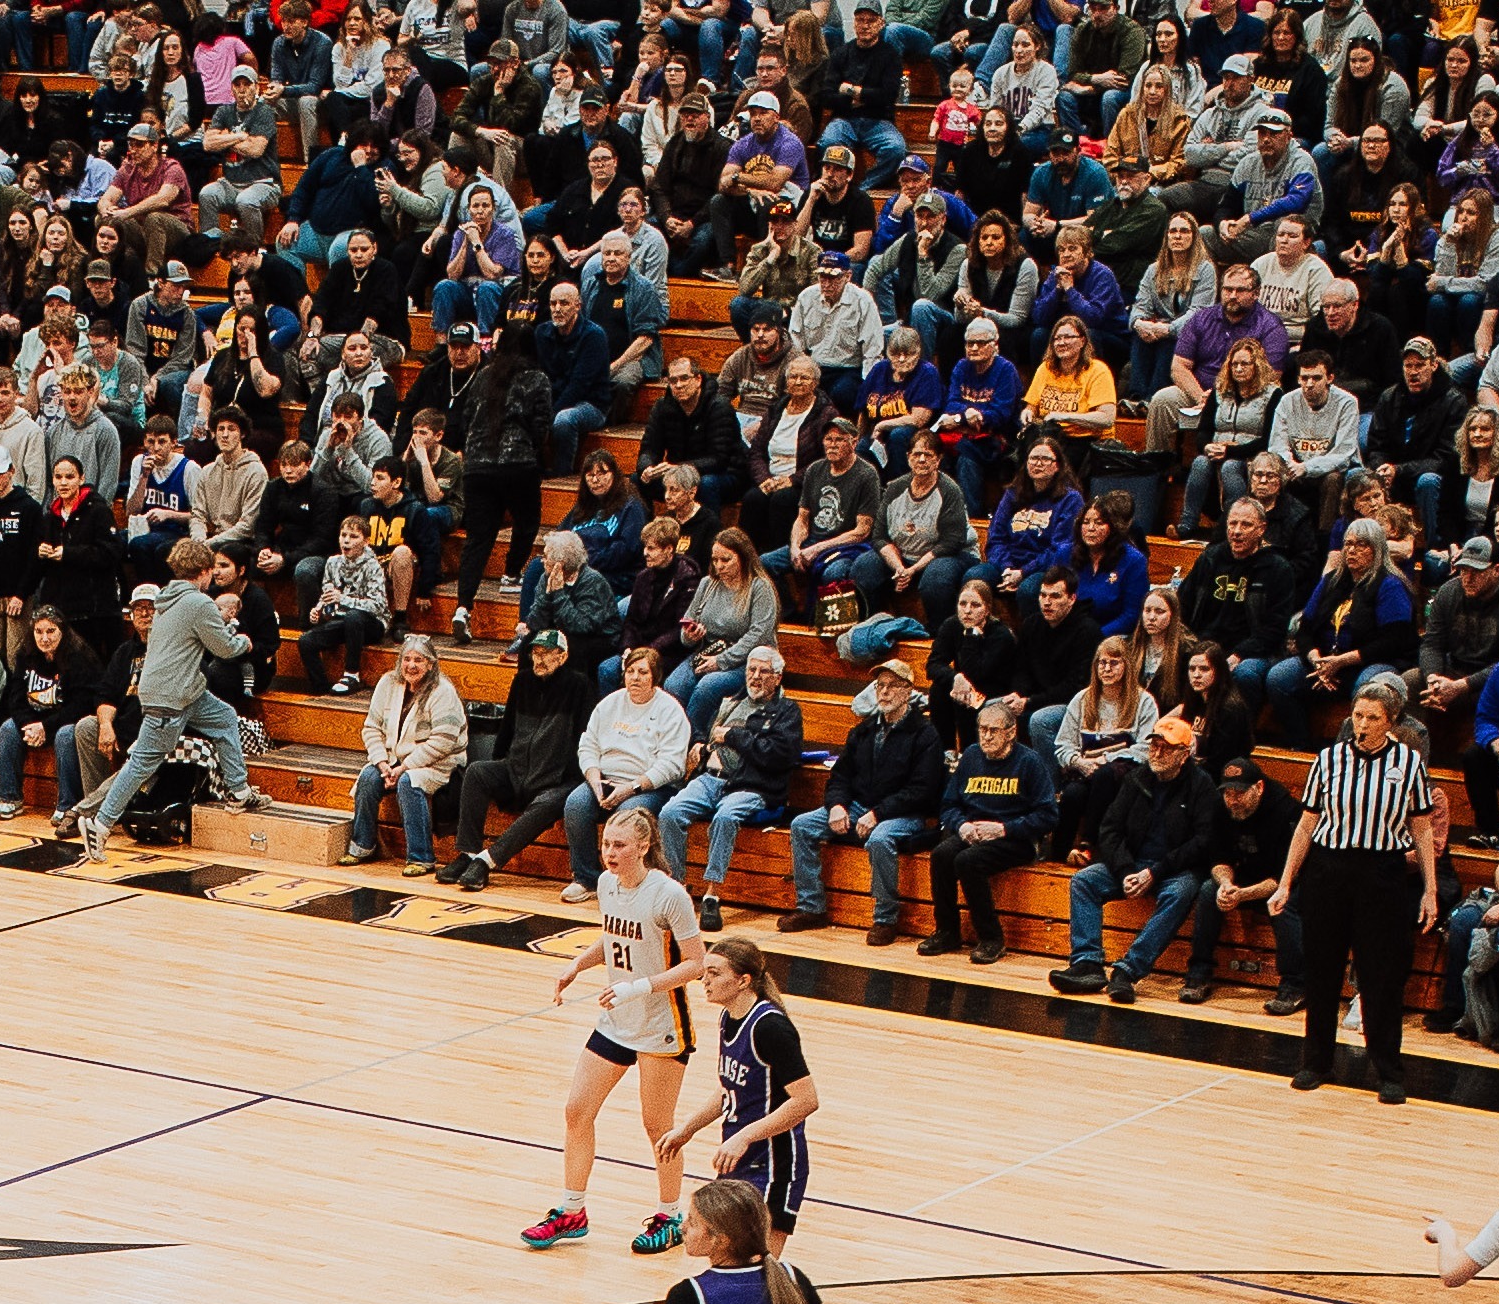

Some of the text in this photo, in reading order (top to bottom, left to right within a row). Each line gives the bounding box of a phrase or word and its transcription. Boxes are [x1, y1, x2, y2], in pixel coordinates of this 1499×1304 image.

[1258, 284, 1299, 313] IKINGS
[611, 942, 635, 973] 21
[717, 1054, 749, 1088] ANSE
